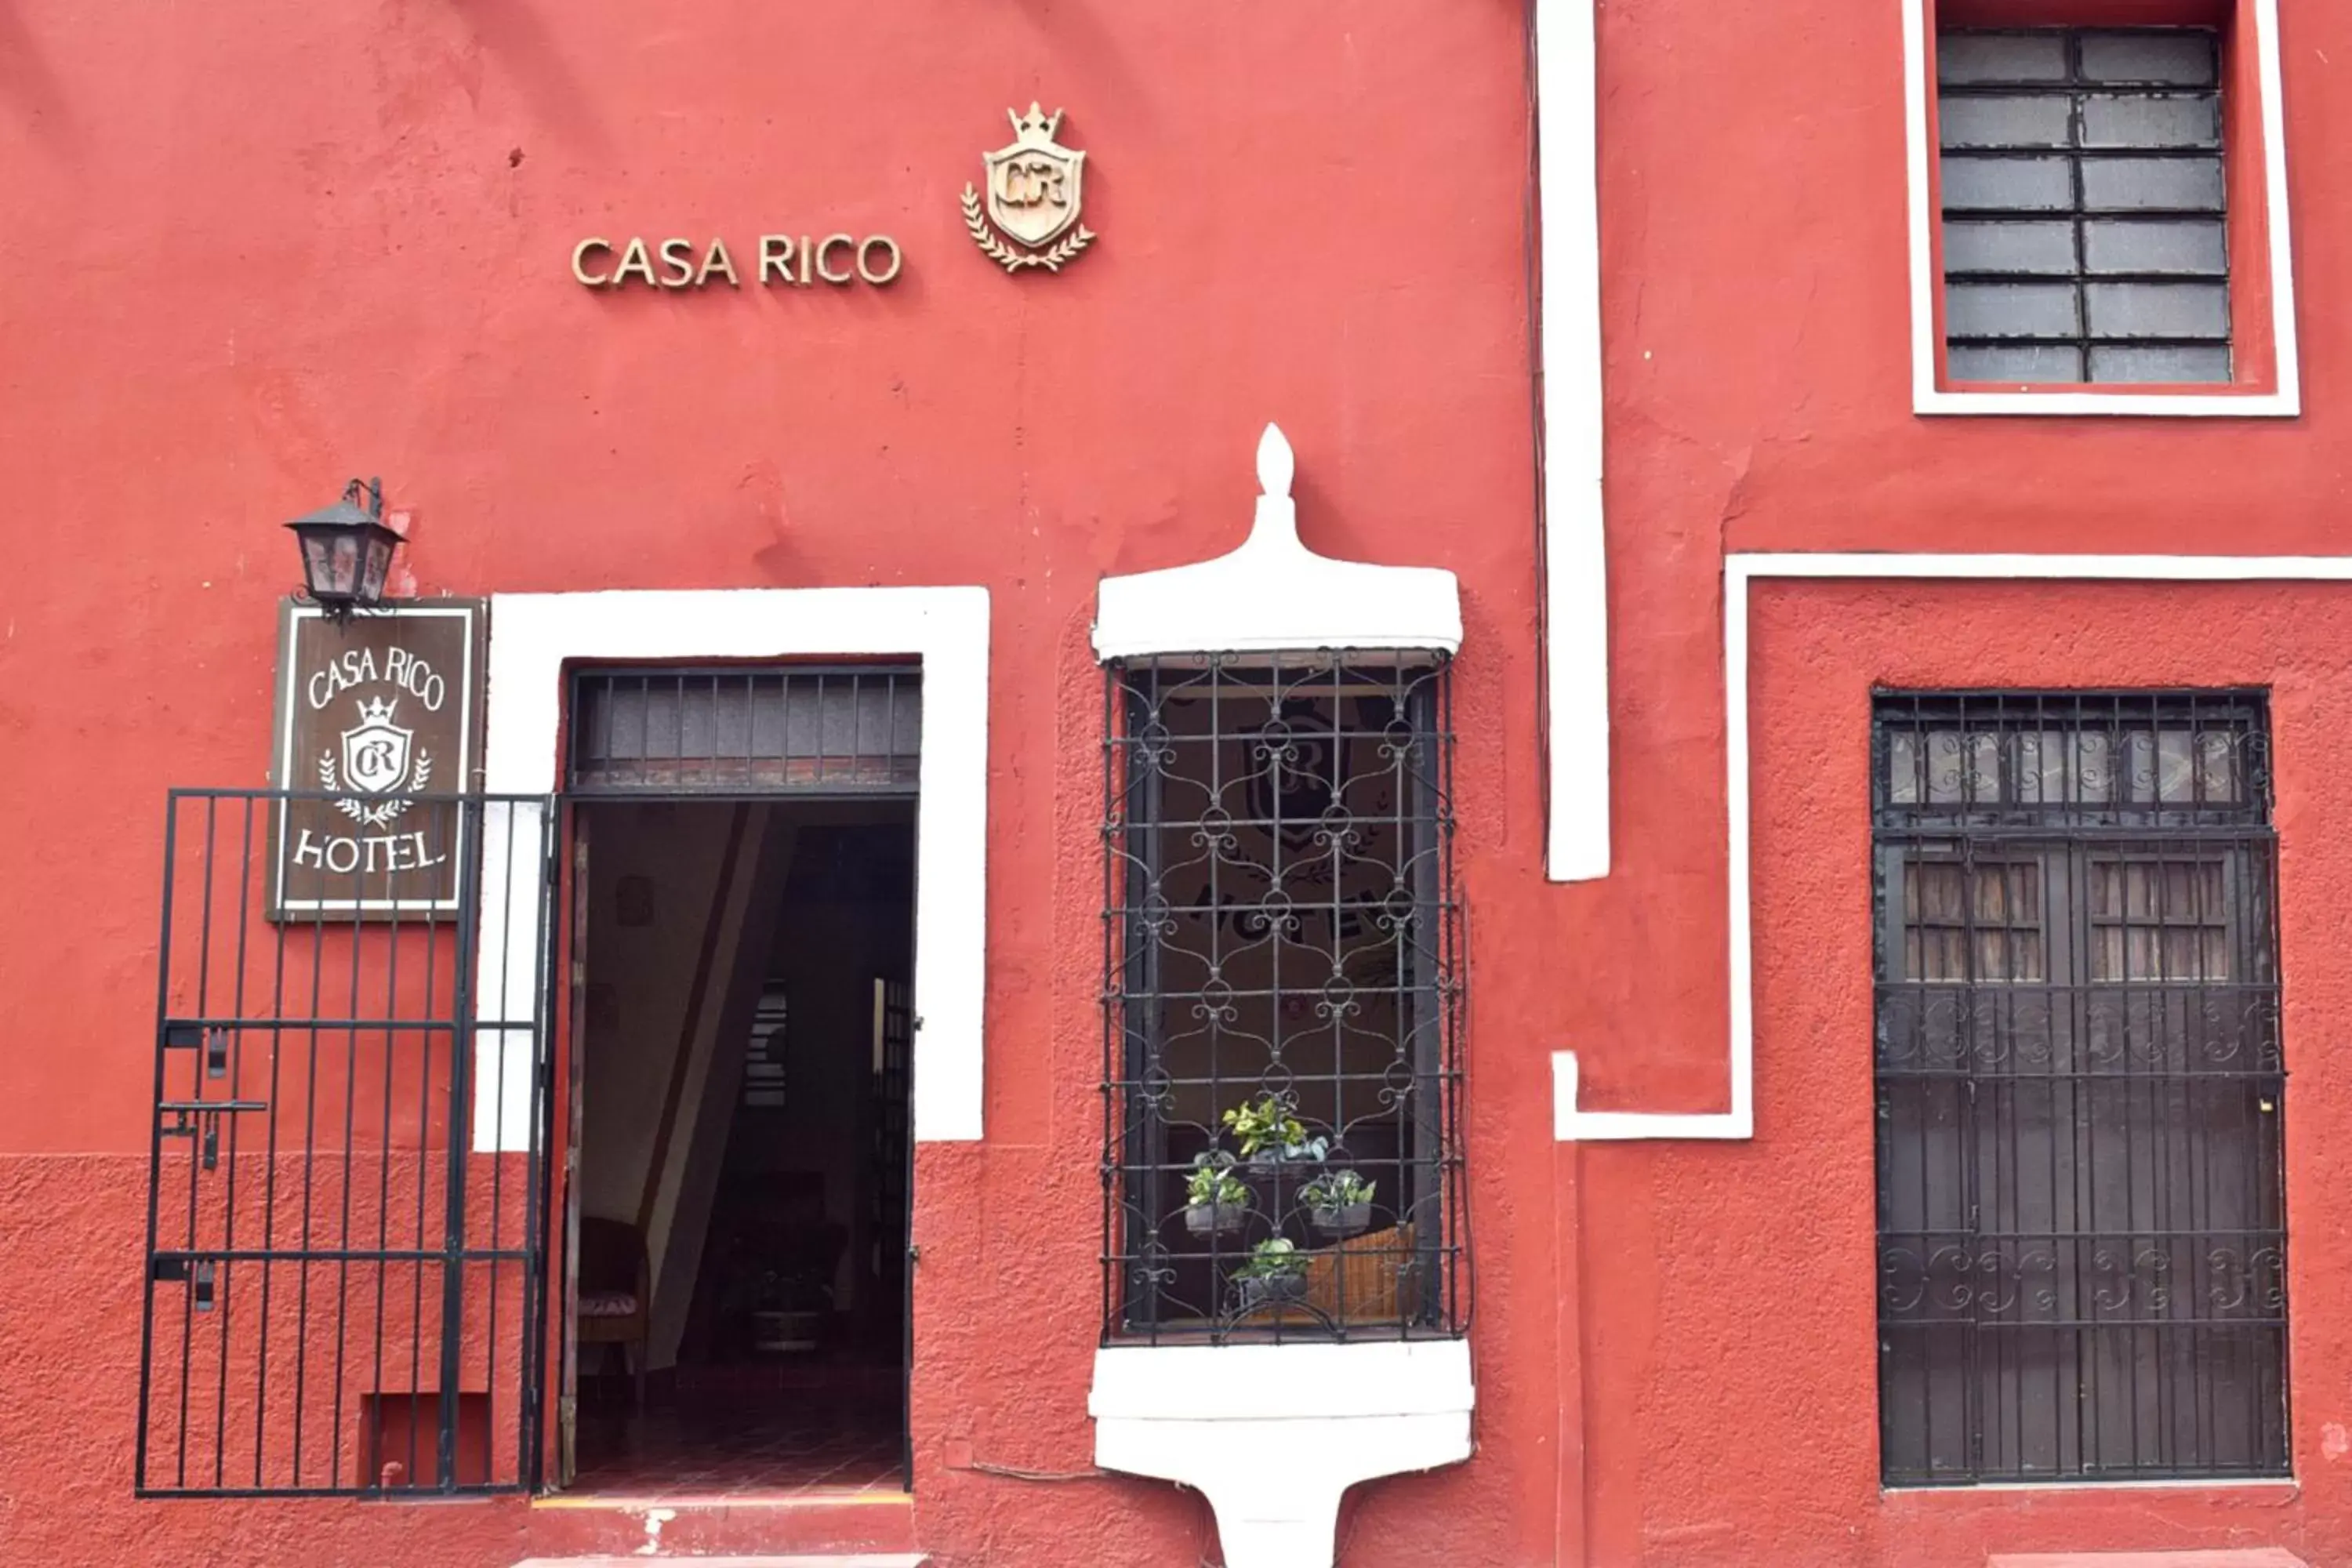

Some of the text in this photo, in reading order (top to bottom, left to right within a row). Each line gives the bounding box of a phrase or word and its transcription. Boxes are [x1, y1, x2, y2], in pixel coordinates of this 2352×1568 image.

[572, 234, 902, 287] CASA RICO
[308, 645, 445, 712] CASA RICO
[355, 740, 395, 777] CR
[292, 829, 447, 874] HOTEL
